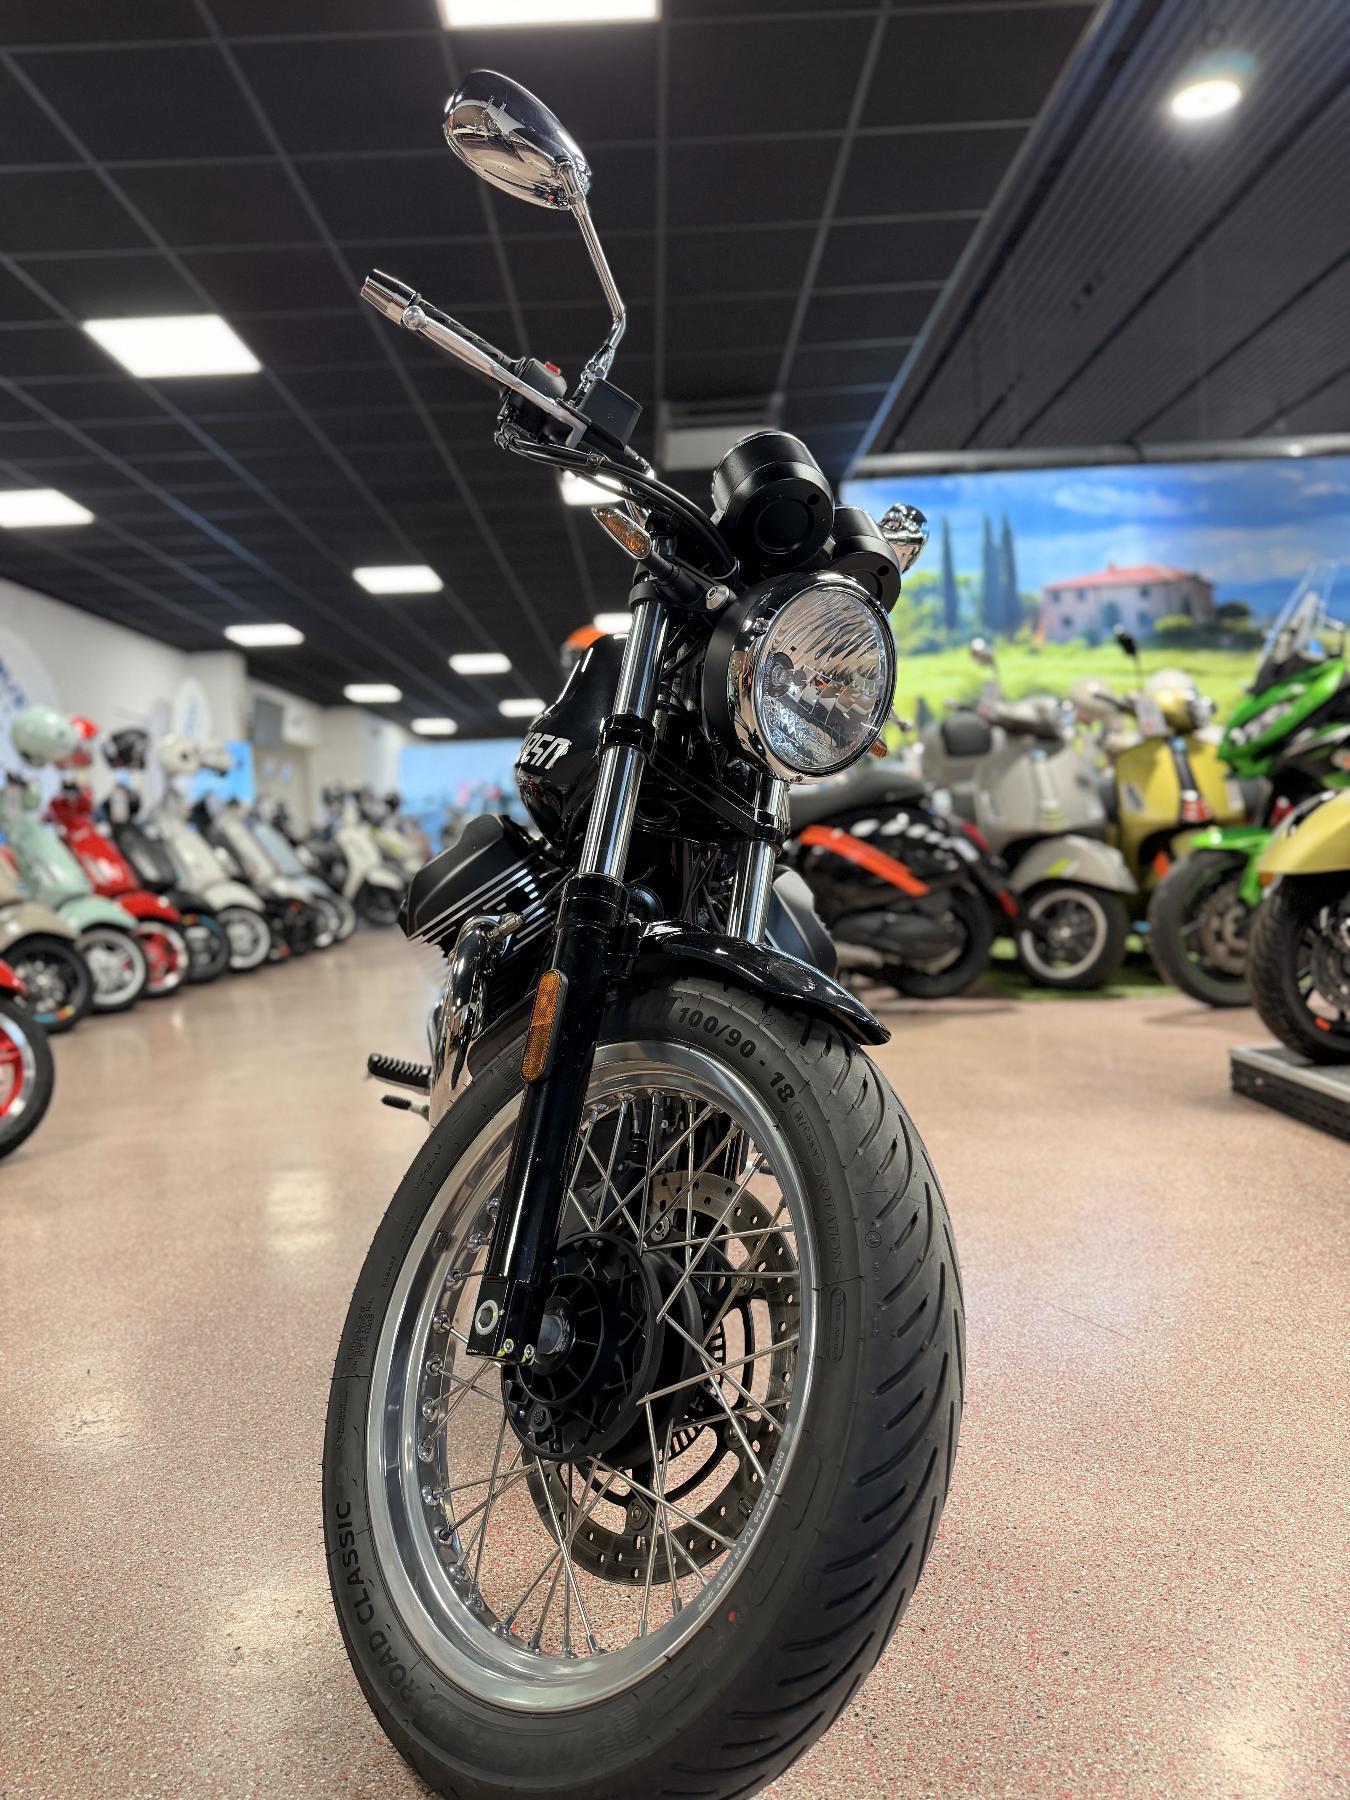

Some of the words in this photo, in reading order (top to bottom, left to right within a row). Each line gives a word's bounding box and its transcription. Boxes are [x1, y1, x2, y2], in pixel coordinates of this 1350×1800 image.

[679, 1007, 757, 1059] 100/90
[769, 1071, 796, 1104] 18
[336, 1502, 375, 1626] CLASSIC
[368, 1629, 420, 1704] ROAD
